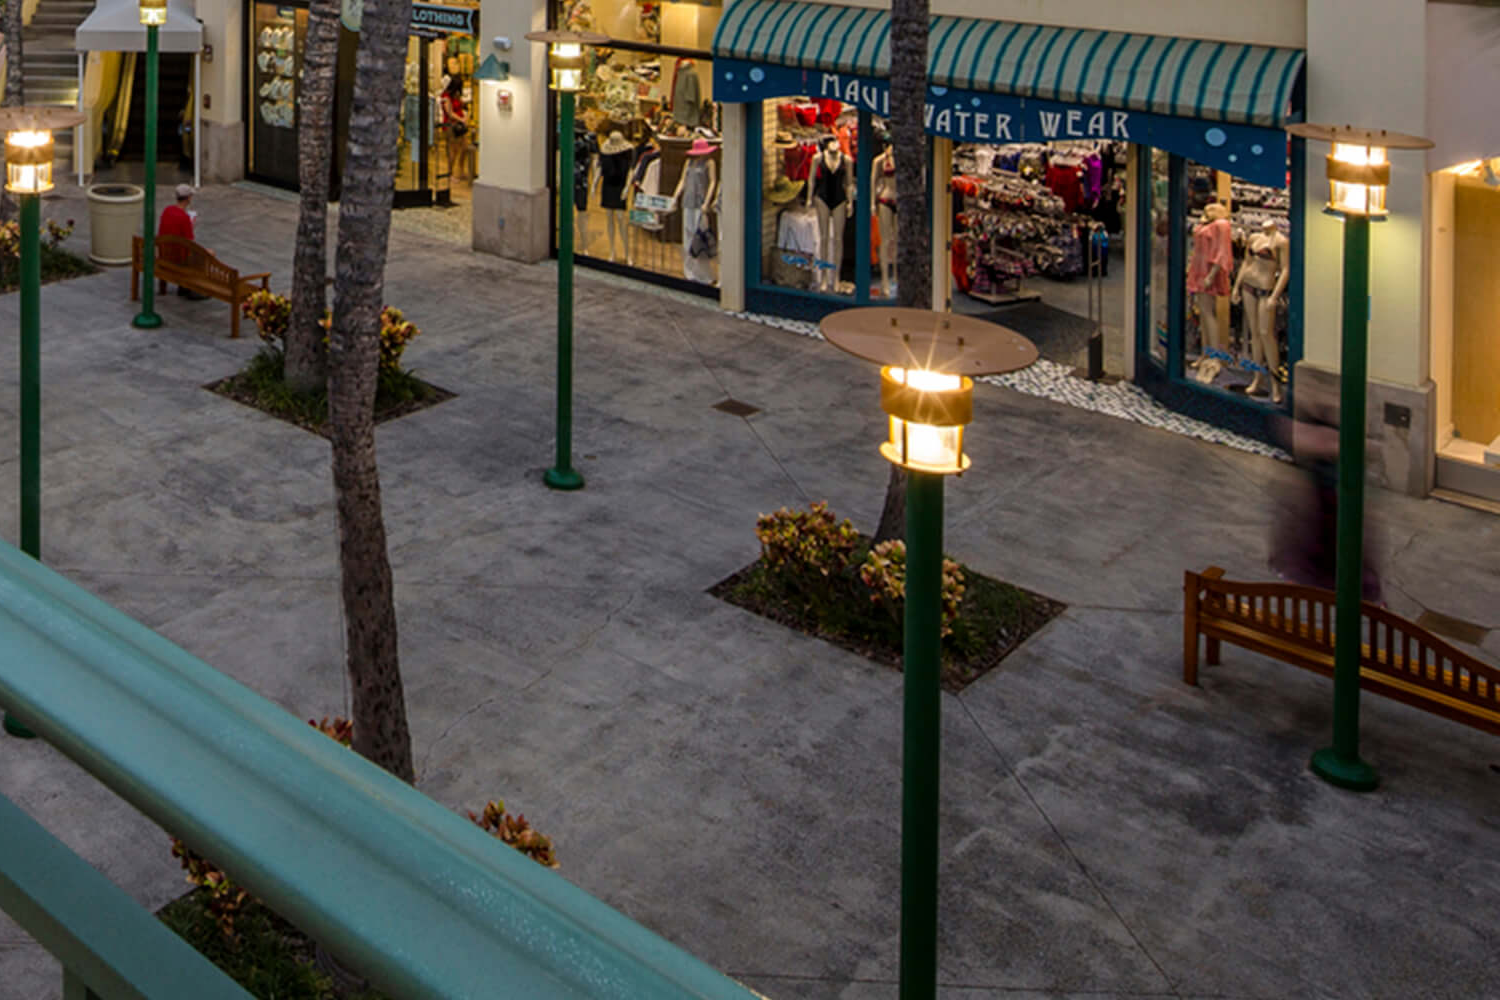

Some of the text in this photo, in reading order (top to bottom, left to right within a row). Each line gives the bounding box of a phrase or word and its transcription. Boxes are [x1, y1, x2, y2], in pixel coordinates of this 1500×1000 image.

[412, 8, 466, 26] LOTHING
[821, 73, 890, 116] MAUI
[1038, 111, 1130, 139] WEAR
